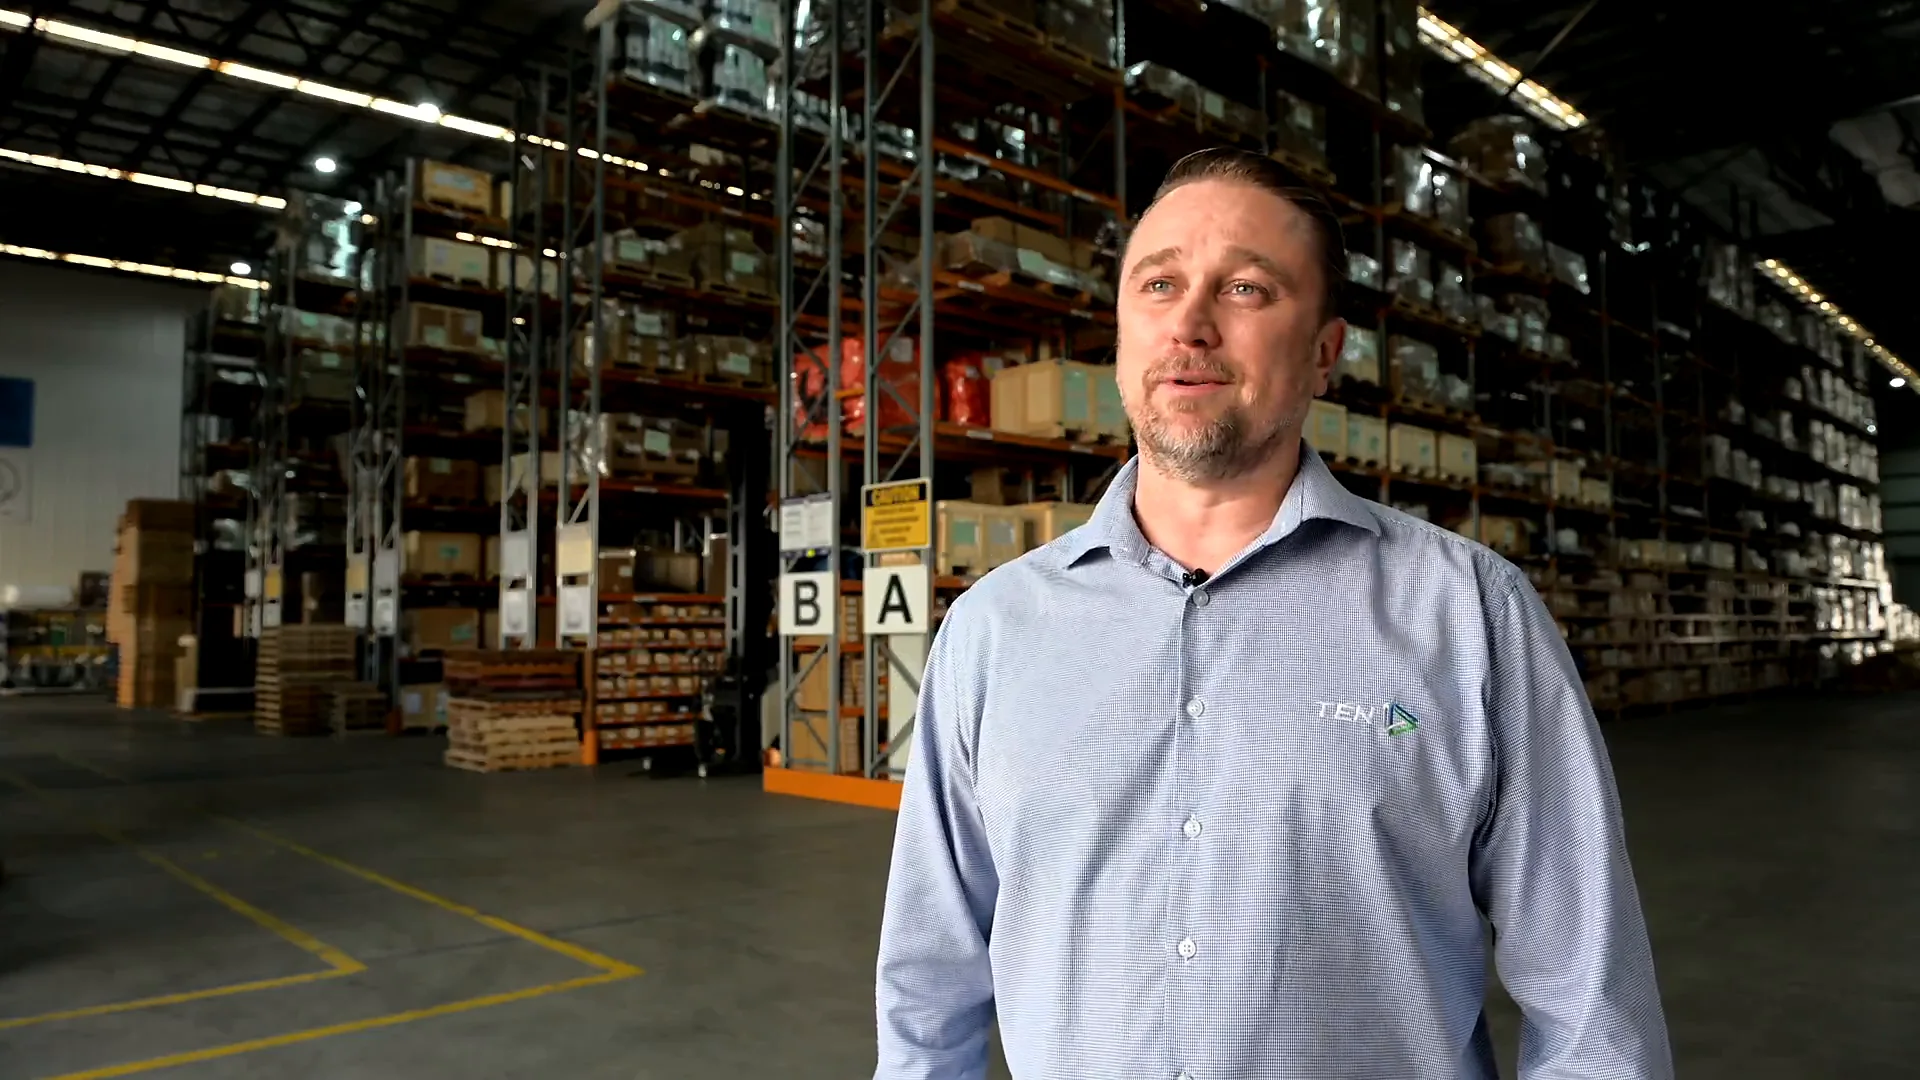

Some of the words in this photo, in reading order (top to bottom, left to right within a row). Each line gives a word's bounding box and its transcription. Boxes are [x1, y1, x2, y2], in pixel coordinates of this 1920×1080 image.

[794, 580, 820, 626] B
[877, 574, 913, 625] A
[1316, 701, 1376, 725] TEN
